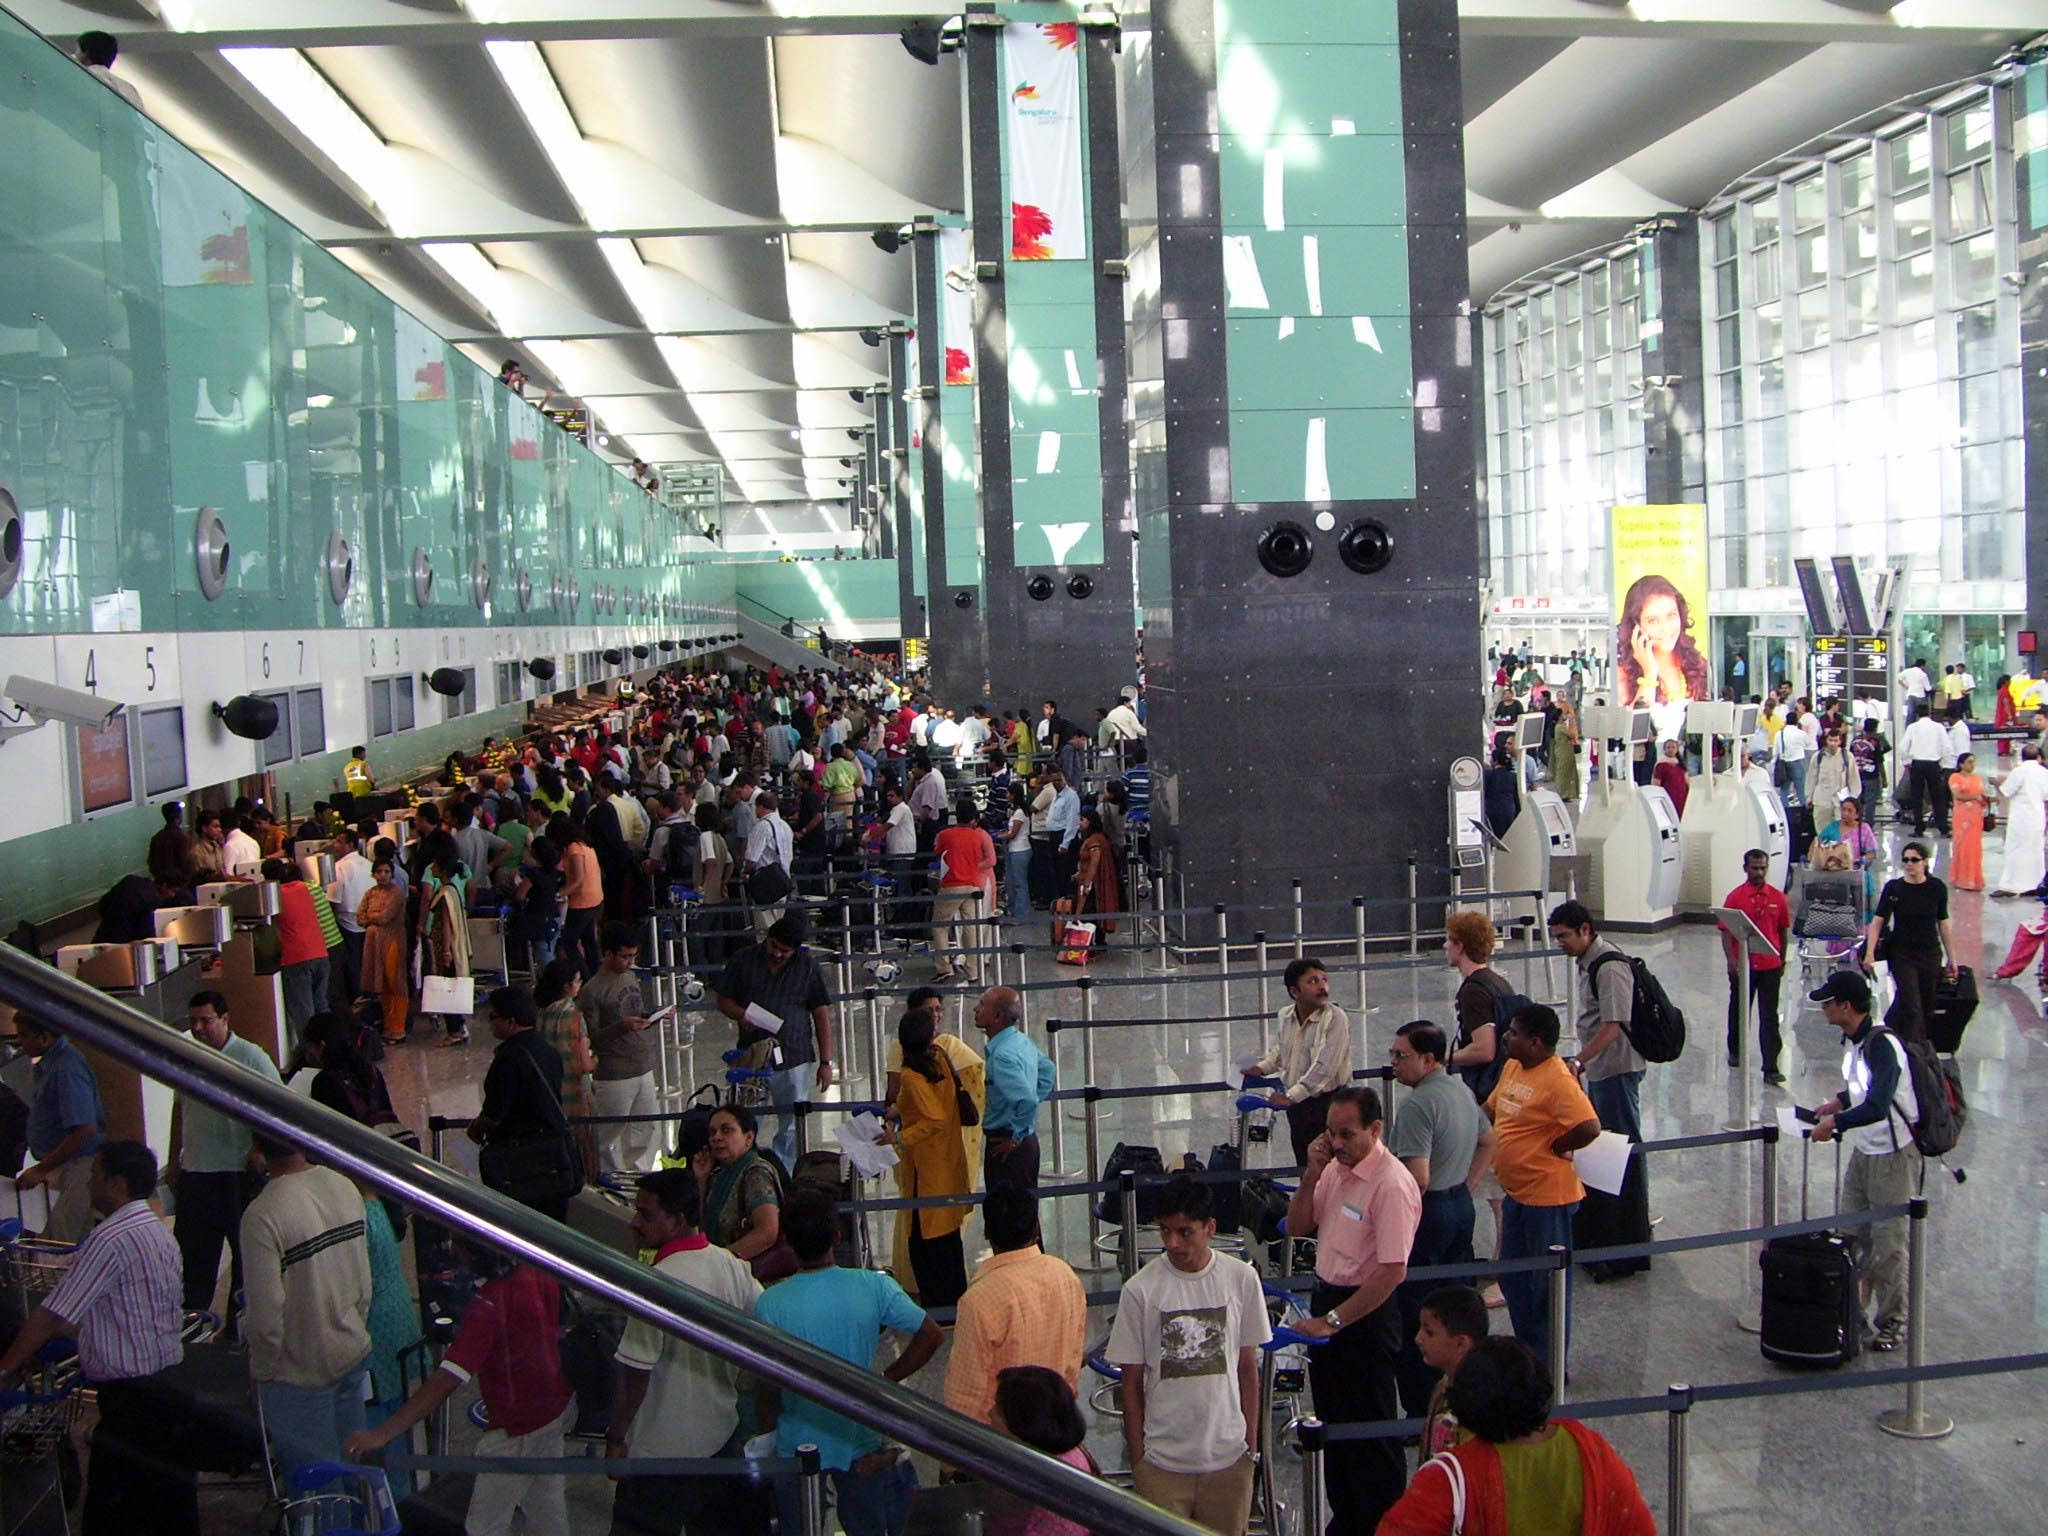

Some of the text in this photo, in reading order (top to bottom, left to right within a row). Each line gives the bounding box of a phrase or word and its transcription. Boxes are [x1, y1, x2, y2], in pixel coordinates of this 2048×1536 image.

[146, 646, 157, 692] 5
[262, 642, 271, 679] 6
[297, 640, 304, 675] 7
[371, 637, 377, 668] 8
[85, 648, 97, 696] 4
